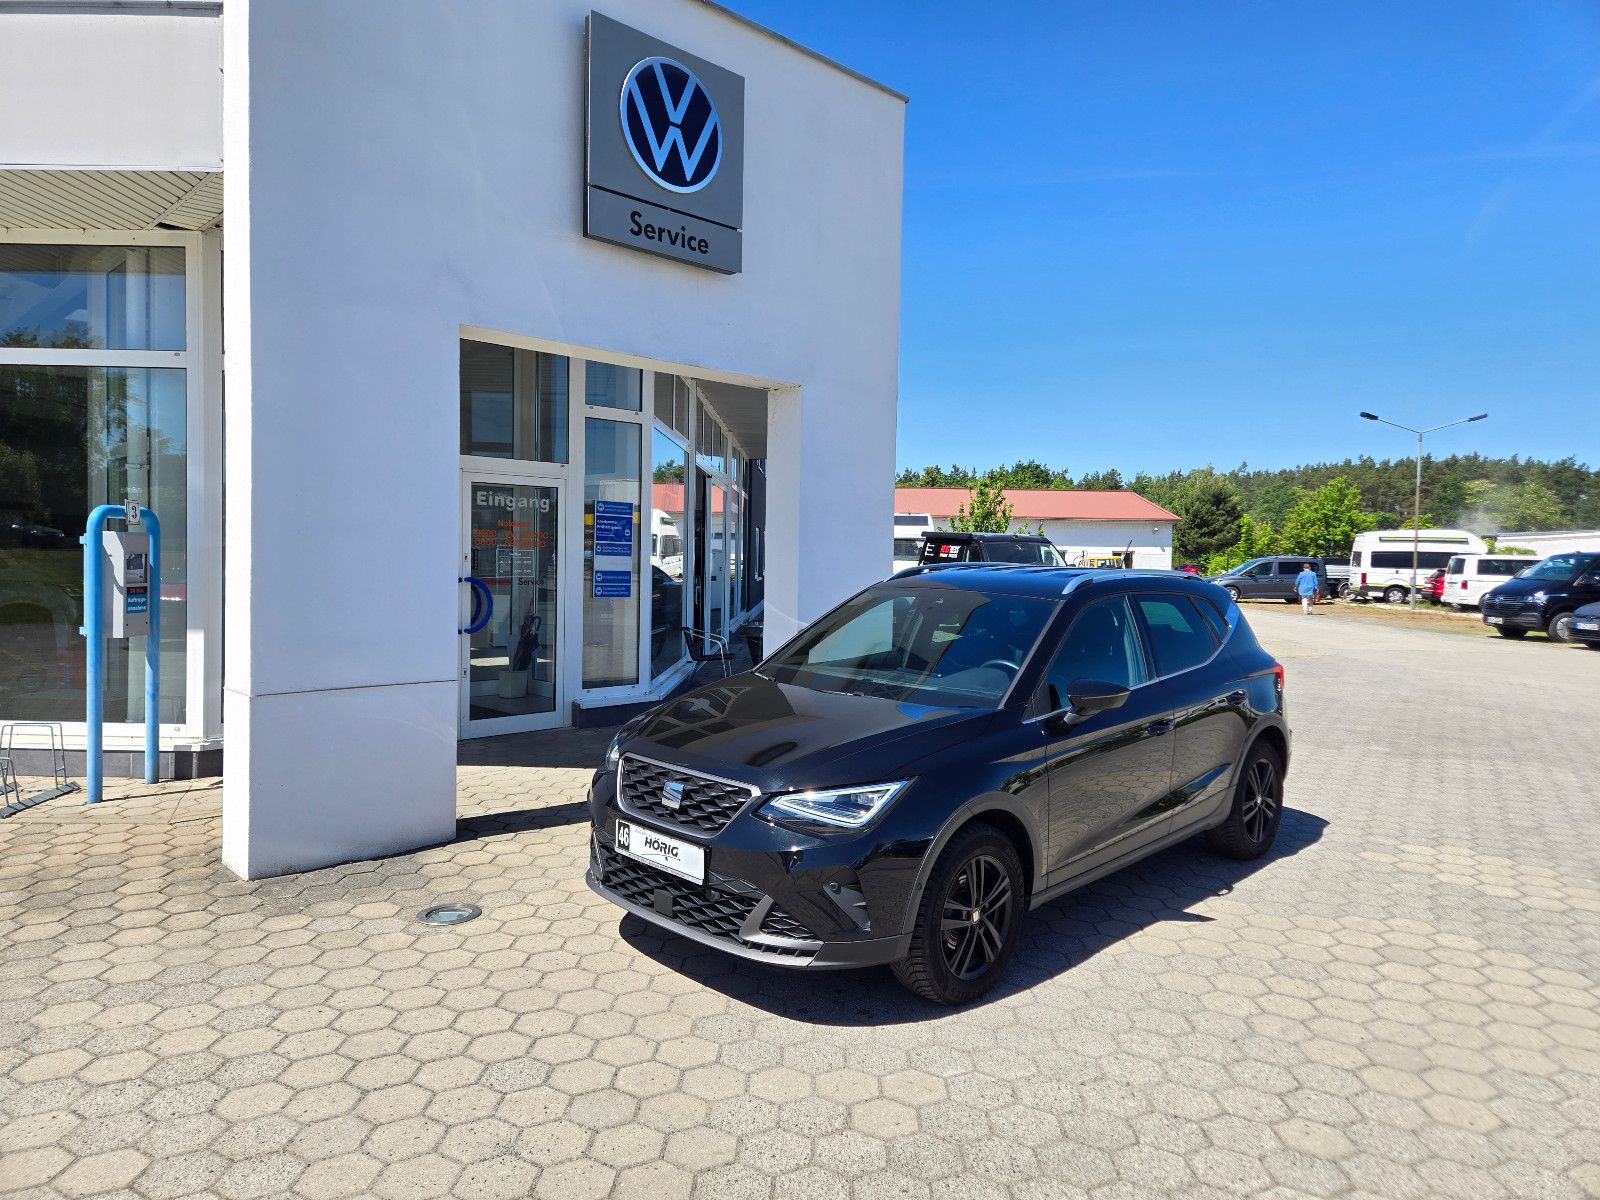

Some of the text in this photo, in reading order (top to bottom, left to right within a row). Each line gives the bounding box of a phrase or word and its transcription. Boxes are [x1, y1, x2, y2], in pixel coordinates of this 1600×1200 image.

[621, 56, 722, 193] VW
[629, 210, 709, 255] Service
[131, 505, 138, 520] 3
[476, 490, 550, 513] Eingang
[517, 577, 545, 586] Service
[618, 825, 630, 847] 46
[644, 836, 679, 857] HÖRIG
